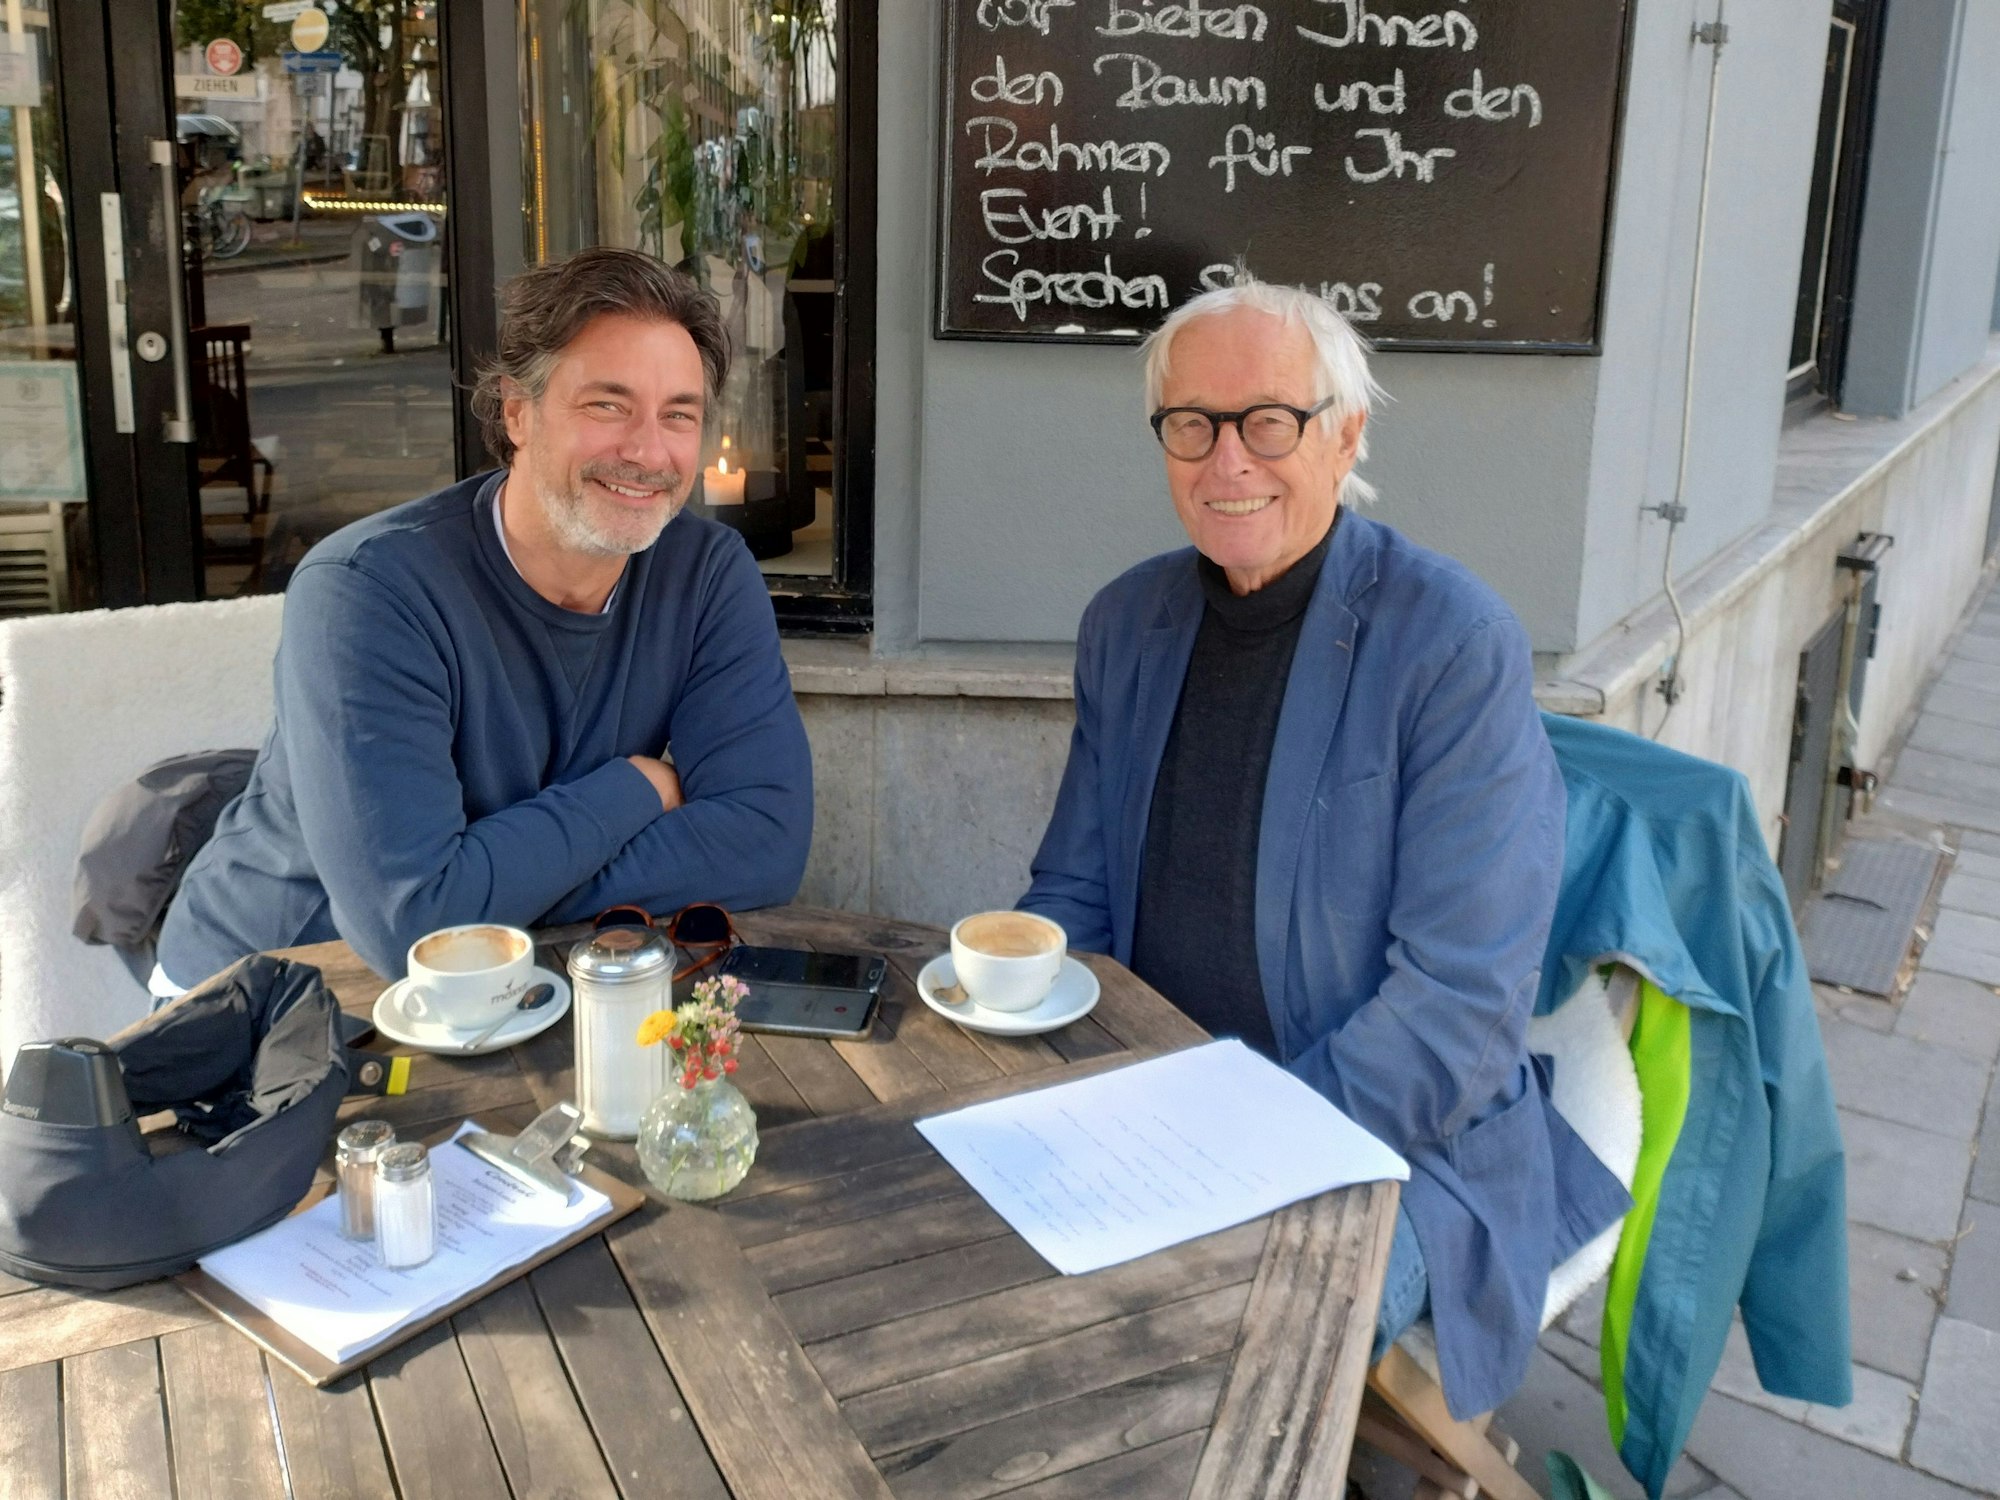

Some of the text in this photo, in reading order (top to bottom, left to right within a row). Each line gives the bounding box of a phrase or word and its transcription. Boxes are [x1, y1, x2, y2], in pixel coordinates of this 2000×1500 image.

[193, 79, 238, 93] ZIEHEN
[971, 53, 1542, 128] den Raum und den
[965, 116, 1171, 177] Rahmen
[1208, 123, 1312, 193] für
[980, 181, 1152, 244] Event!
[971, 249, 1170, 322] Sprechen
[1408, 262, 1497, 328] an!
